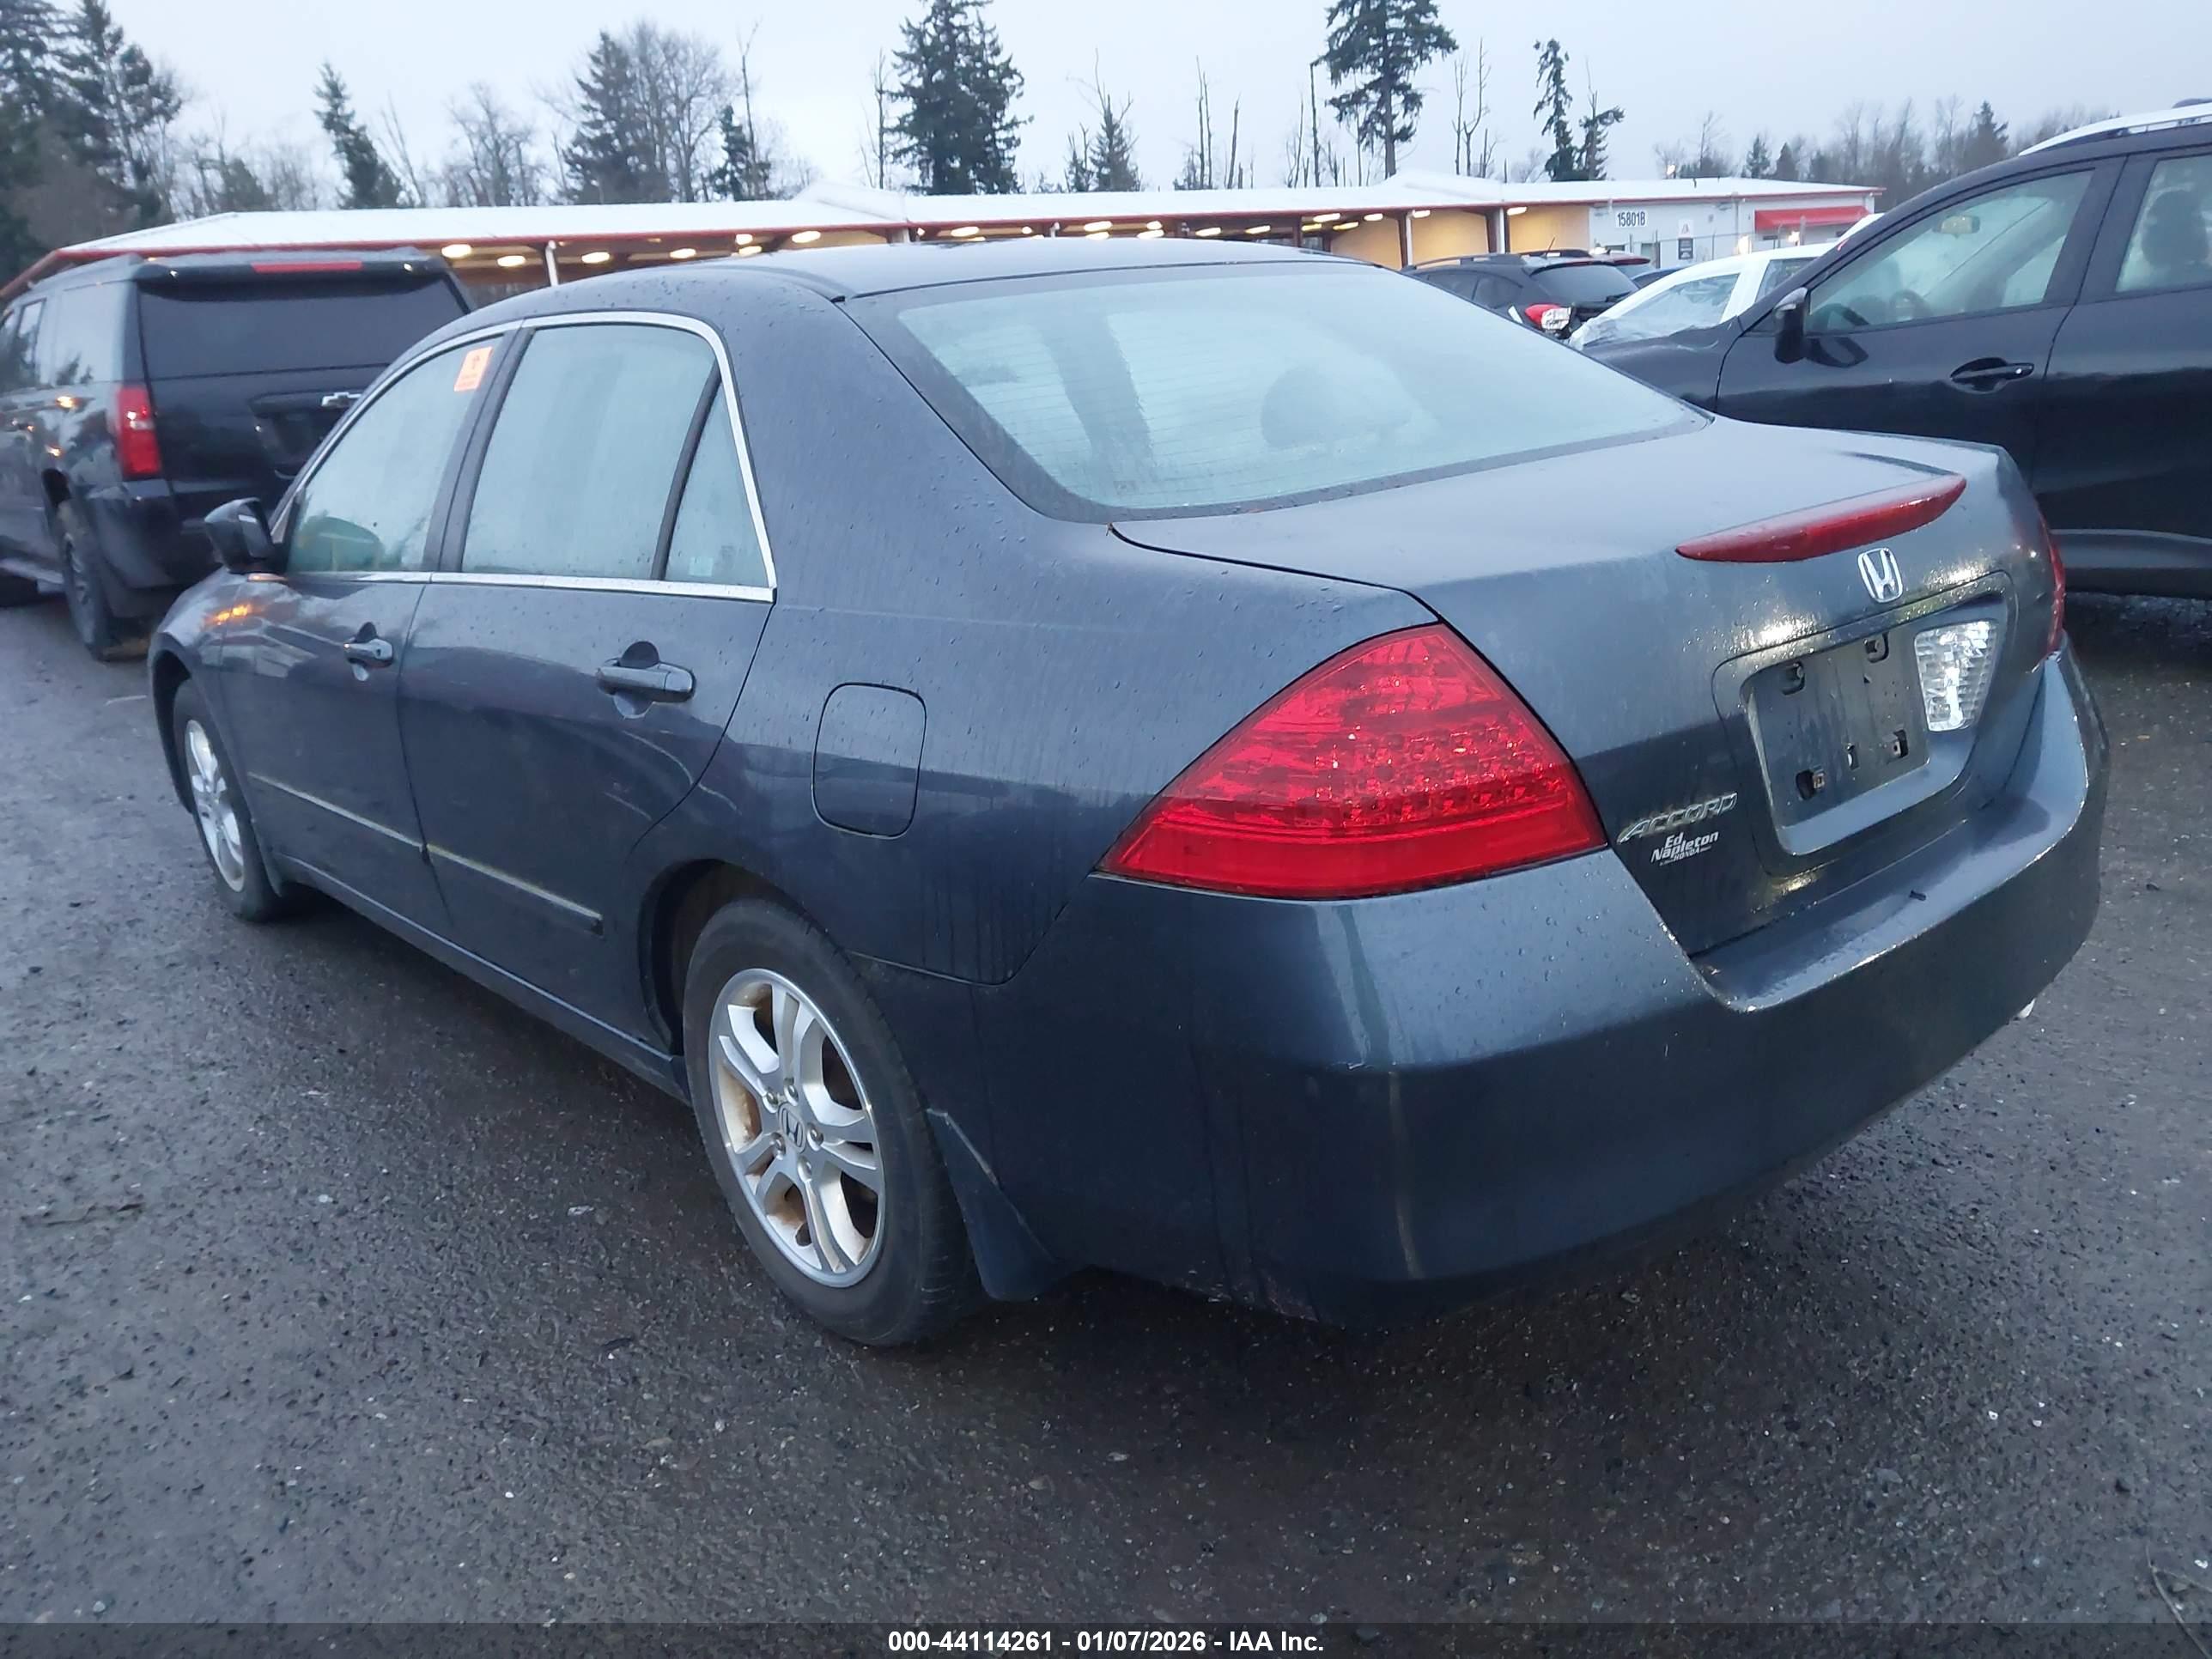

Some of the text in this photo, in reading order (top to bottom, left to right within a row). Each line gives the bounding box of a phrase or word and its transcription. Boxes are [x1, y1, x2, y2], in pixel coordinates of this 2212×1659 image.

[1617, 211, 1646, 227] 15801B
[1617, 793, 1738, 844] ACCORD
[1650, 831, 1719, 863] Napleton
[1665, 831, 1684, 848] Ed
